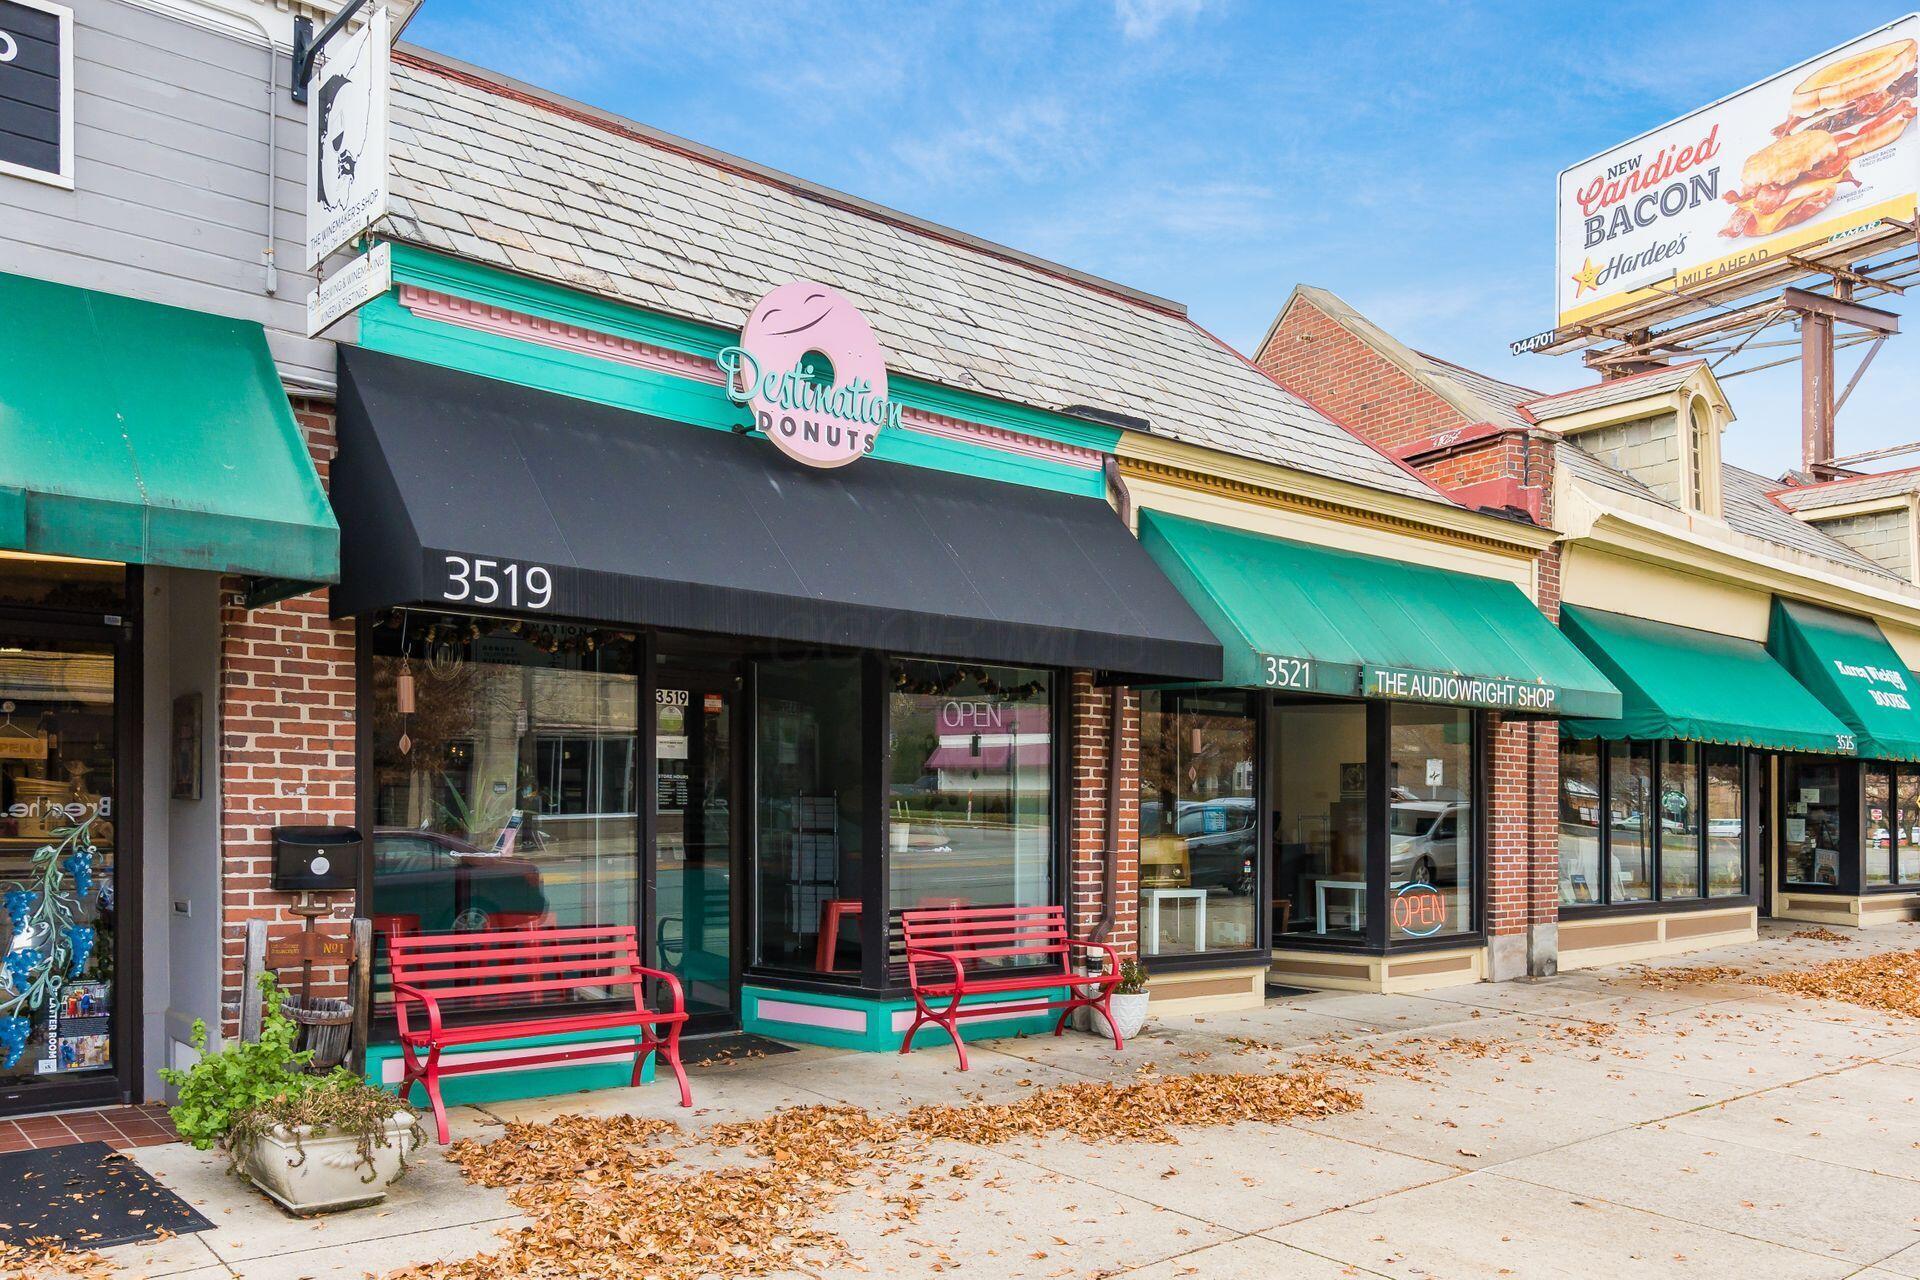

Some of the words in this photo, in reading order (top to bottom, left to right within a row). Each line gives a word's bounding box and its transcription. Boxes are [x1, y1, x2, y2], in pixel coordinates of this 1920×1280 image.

[1577, 123, 1721, 217] Candied
[1607, 154, 1642, 180] NEW
[311, 233, 321, 249] THE
[360, 188, 378, 212] SHOP
[1584, 166, 1720, 249] BACON
[1594, 232, 1688, 287] Hardee's
[1682, 265, 1712, 287] MILE
[1717, 249, 1769, 276] AHEAD
[1513, 331, 1554, 355] 044701
[716, 346, 904, 430] Destination
[756, 410, 876, 454] DONUTS
[443, 556, 552, 608] 3519
[1266, 656, 1310, 688] 3521
[1375, 670, 1407, 696] THE
[1410, 675, 1515, 704] AUDIOWRIGHT
[1518, 682, 1554, 708] SHOP
[656, 690, 688, 705] 3519
[943, 701, 1001, 727] OPEN
[0, 742, 31, 753] PEN
[1393, 894, 1446, 927] OPEN
[48, 1033, 57, 1059] ROOM
